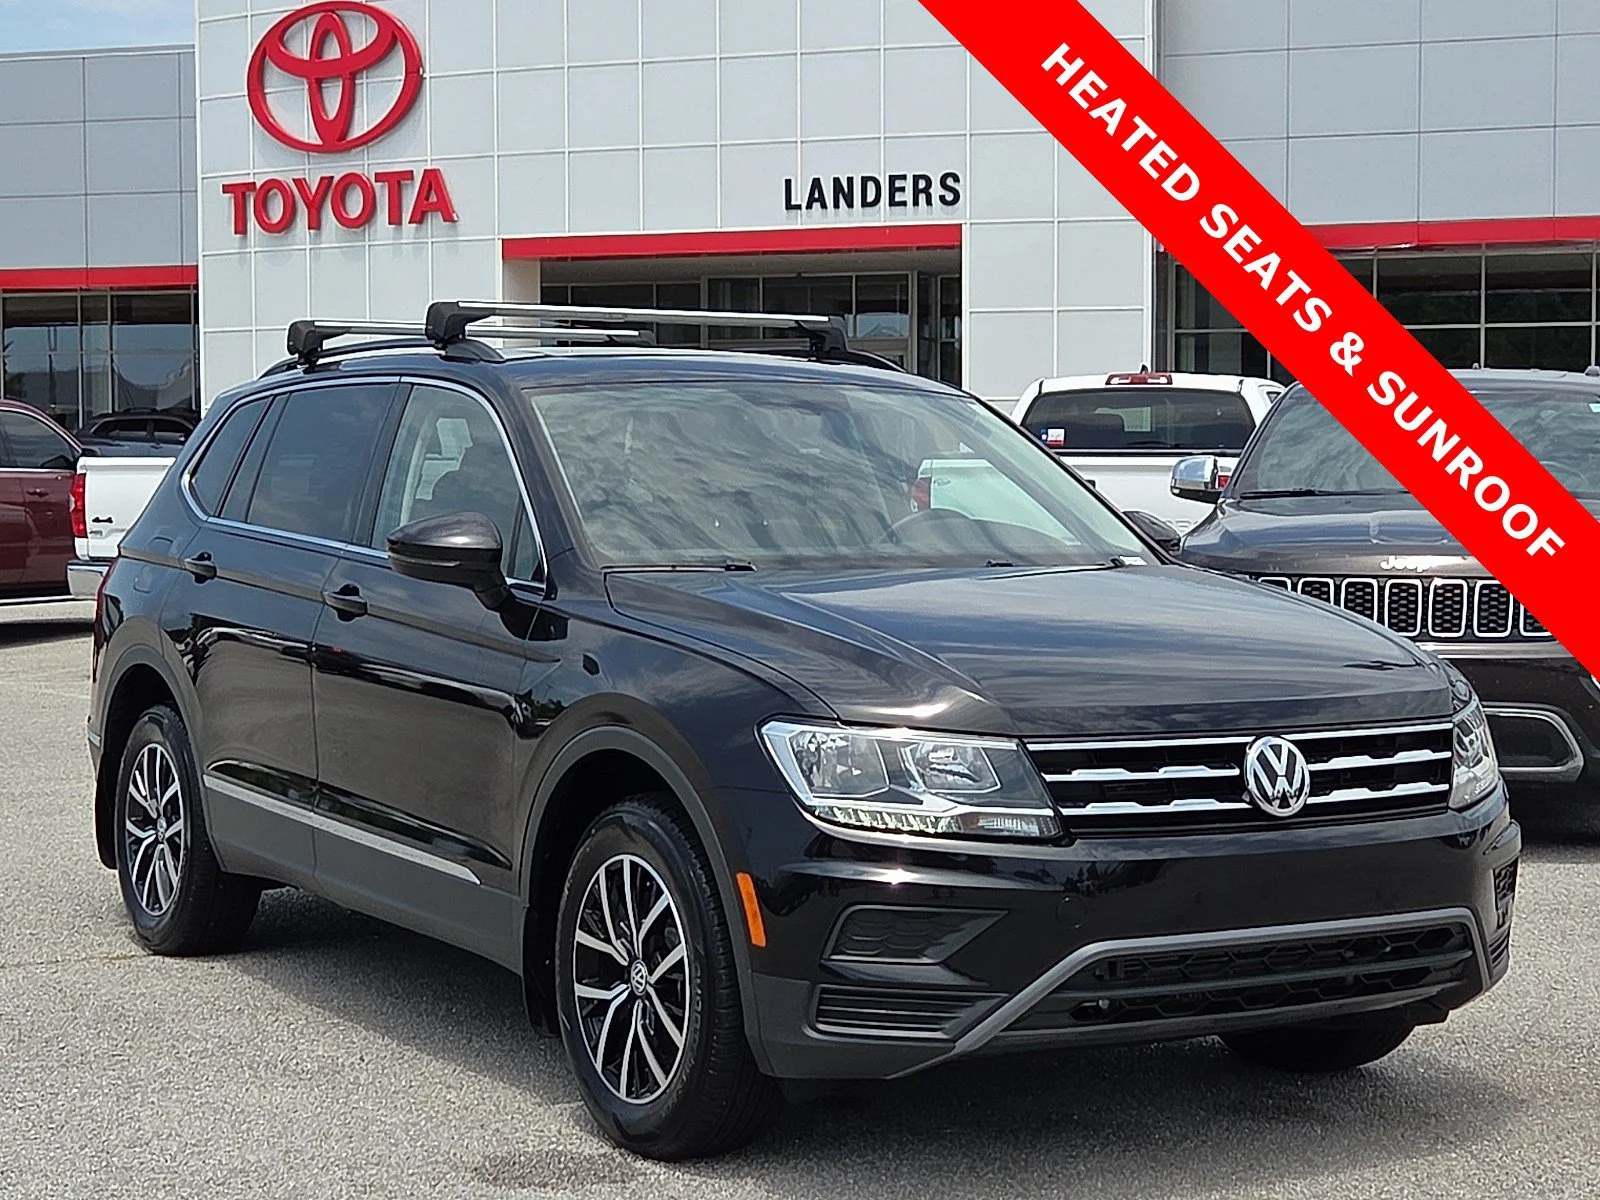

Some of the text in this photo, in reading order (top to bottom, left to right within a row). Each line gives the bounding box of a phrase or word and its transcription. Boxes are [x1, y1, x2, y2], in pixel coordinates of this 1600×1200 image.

[222, 168, 458, 236] TOYOTA
[784, 171, 961, 211] LANDERS
[1379, 555, 1431, 573] Jeep
